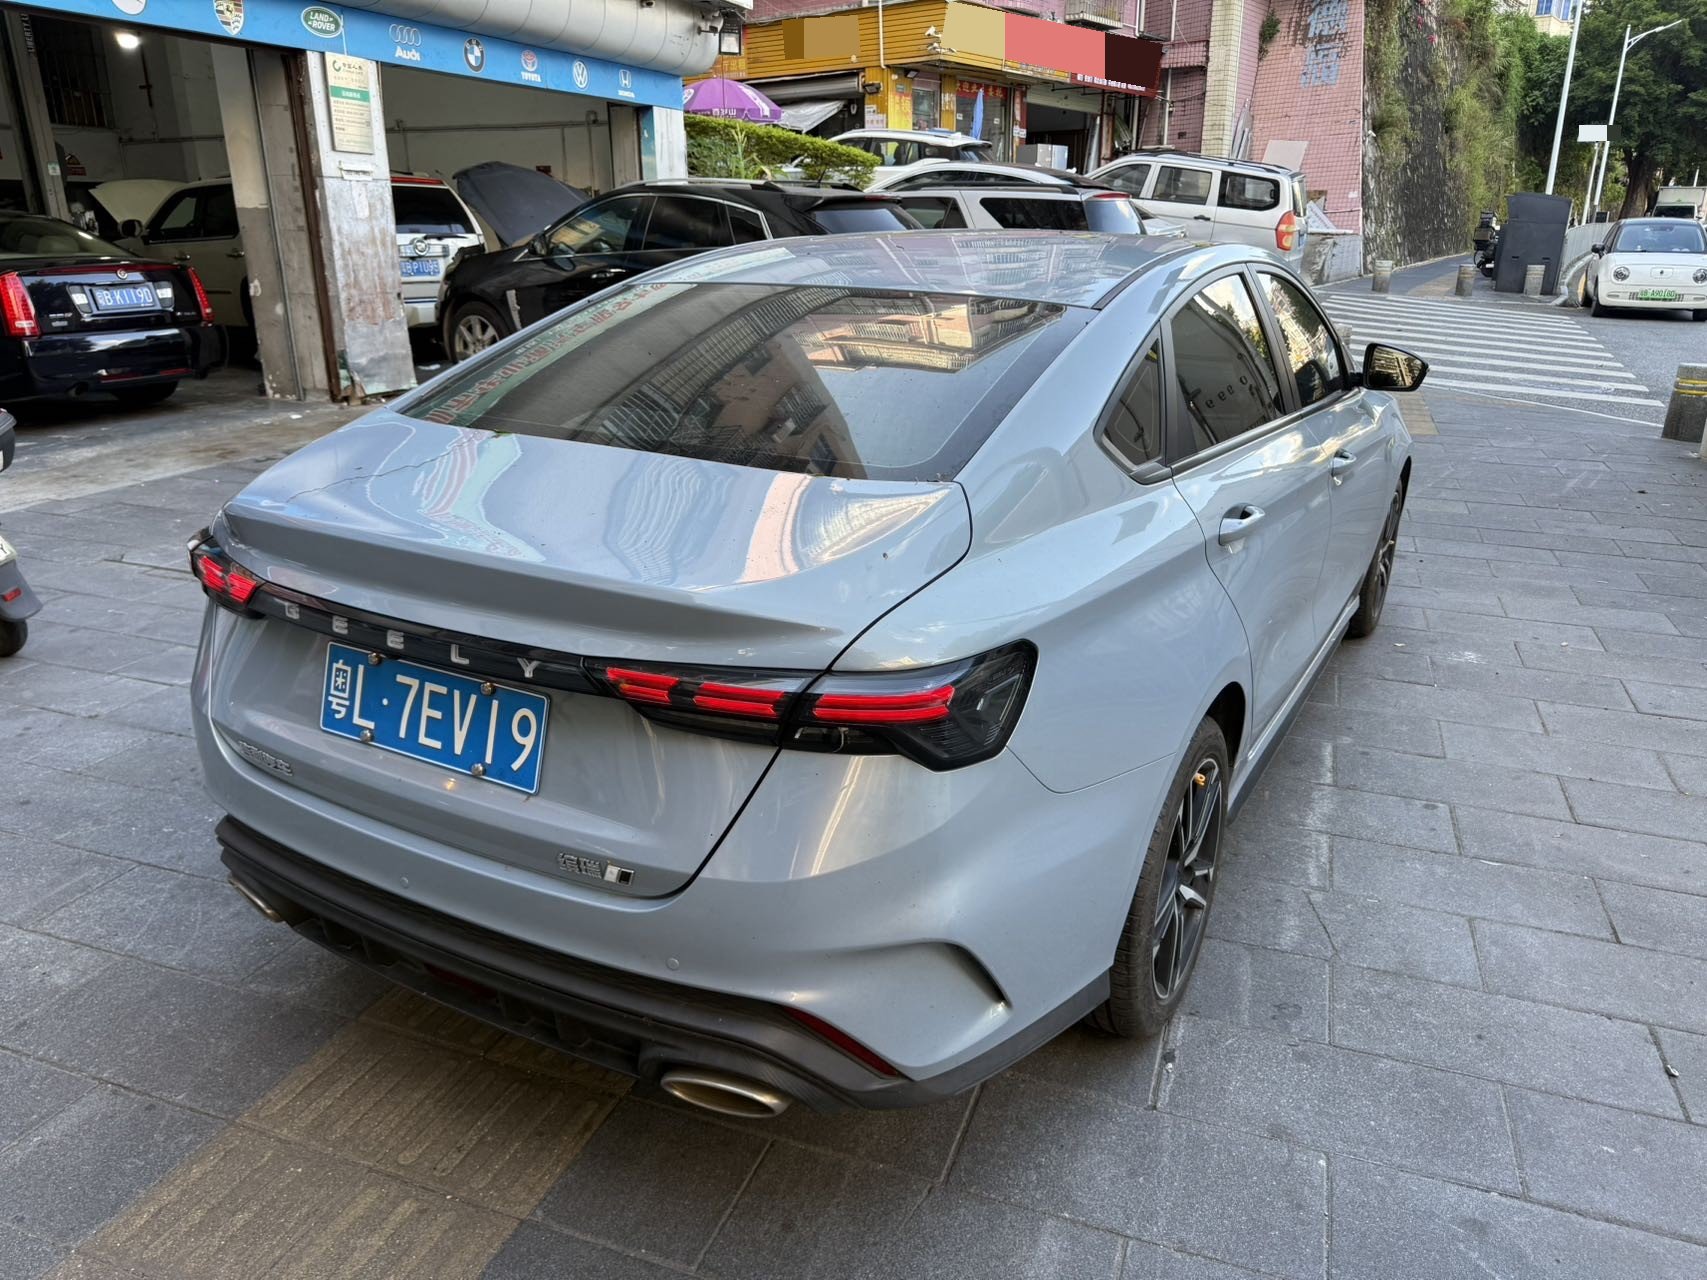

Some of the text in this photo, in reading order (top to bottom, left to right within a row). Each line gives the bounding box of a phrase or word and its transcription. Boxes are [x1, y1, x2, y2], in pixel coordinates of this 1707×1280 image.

[310, 11, 329, 21] LAND
[311, 21, 336, 32] ROVER
[394, 45, 421, 61] Audi
[521, 71, 542, 83] TOYOTA
[284, 601, 542, 679] GEELY
